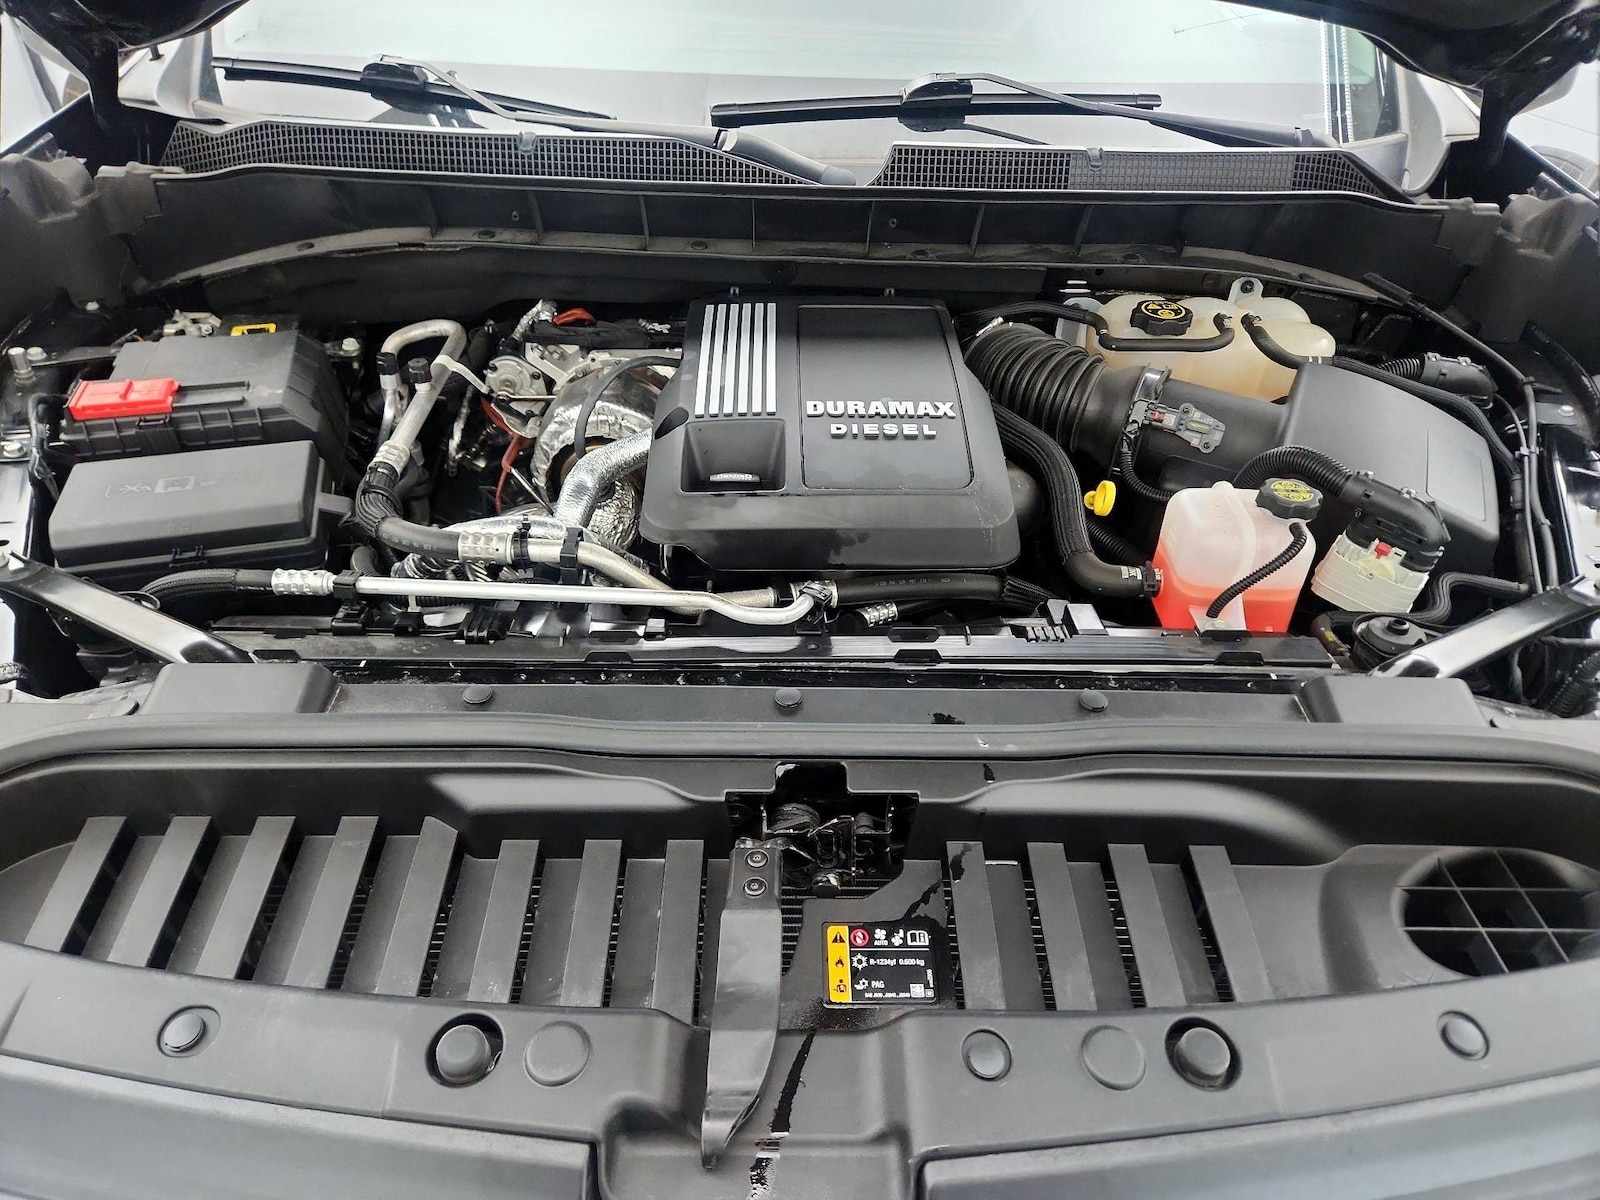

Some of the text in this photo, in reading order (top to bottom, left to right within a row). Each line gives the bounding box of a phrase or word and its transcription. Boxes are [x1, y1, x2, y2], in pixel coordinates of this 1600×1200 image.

[806, 400, 957, 419] DURAMAX
[830, 423, 937, 439] DIESEL
[916, 958, 925, 967] kg
[871, 981, 885, 989] PAG
